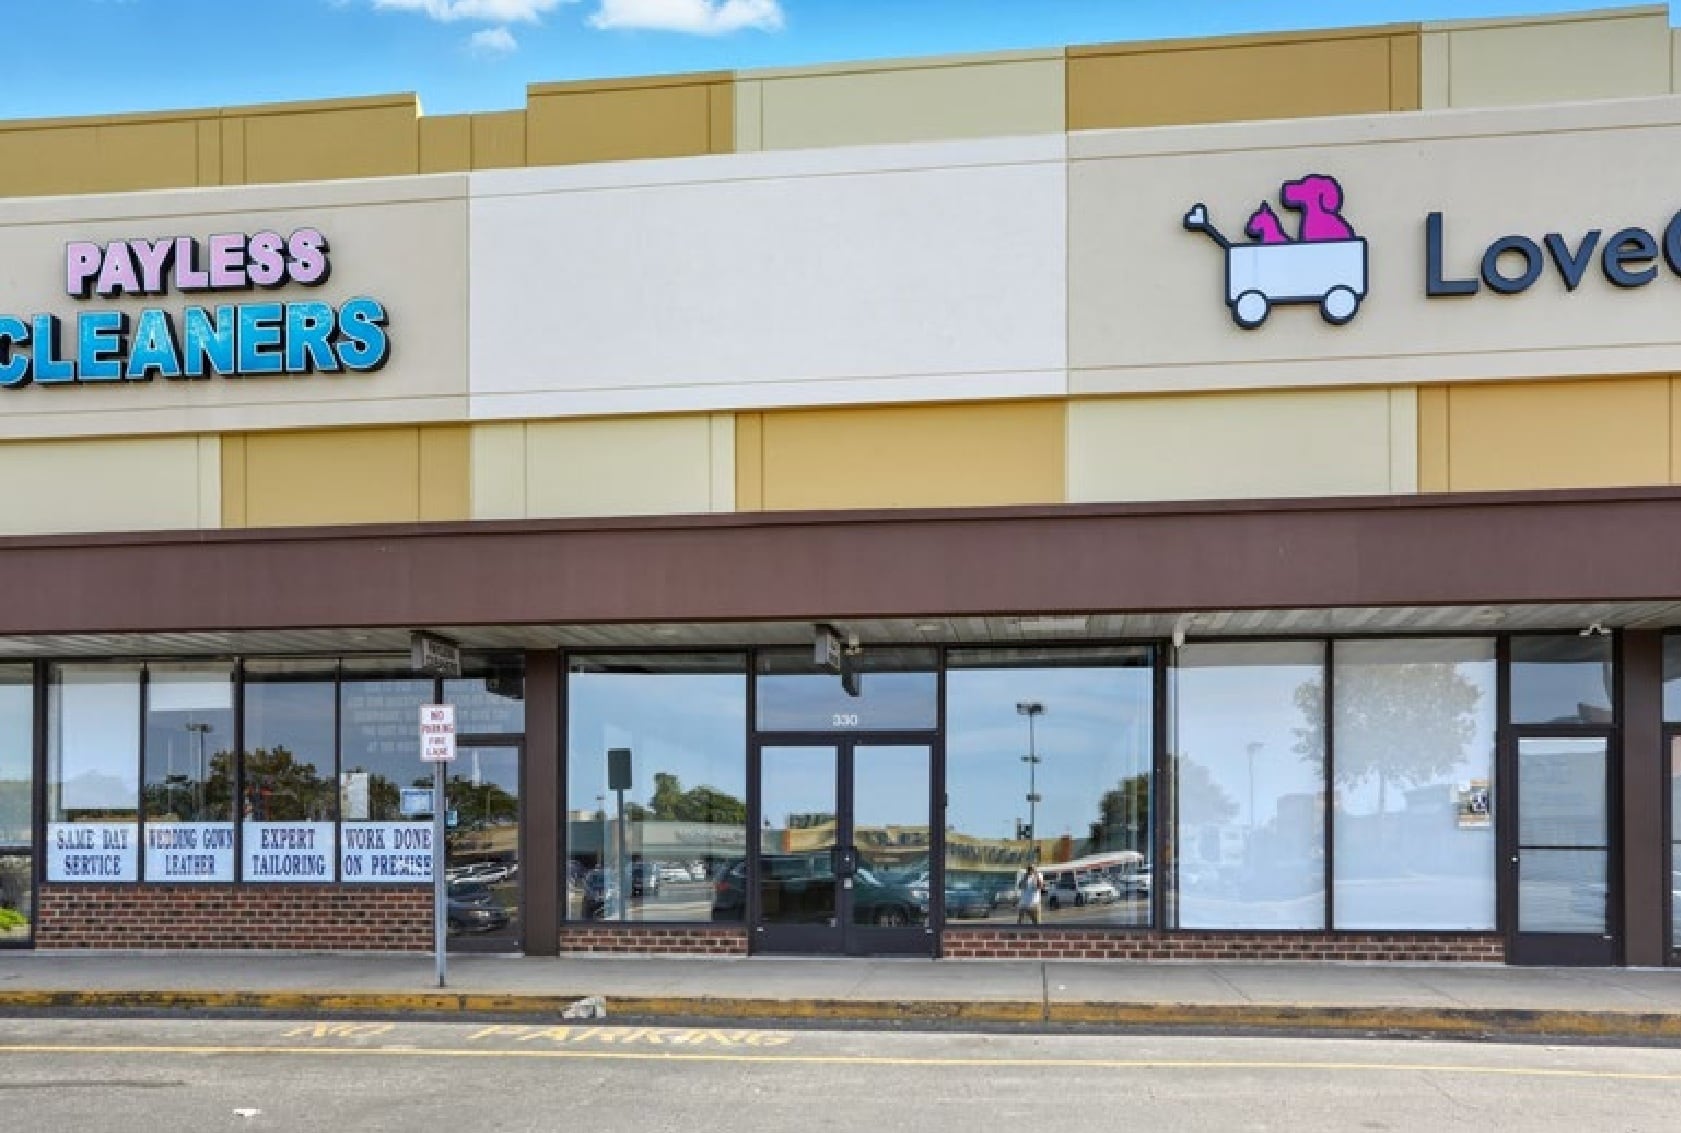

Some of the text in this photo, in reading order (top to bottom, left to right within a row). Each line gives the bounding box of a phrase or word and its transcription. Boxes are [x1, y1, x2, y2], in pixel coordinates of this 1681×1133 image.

[66, 228, 330, 297] PAYLESS
[57, 829, 129, 849] SAME DAY
[261, 828, 315, 849] EXPERT
[346, 828, 432, 849] WORK DONE
[65, 854, 121, 875] SERVICE
[165, 854, 215, 875] LEATHER
[252, 854, 326, 875] TAILORING
[345, 854, 363, 875] ON
